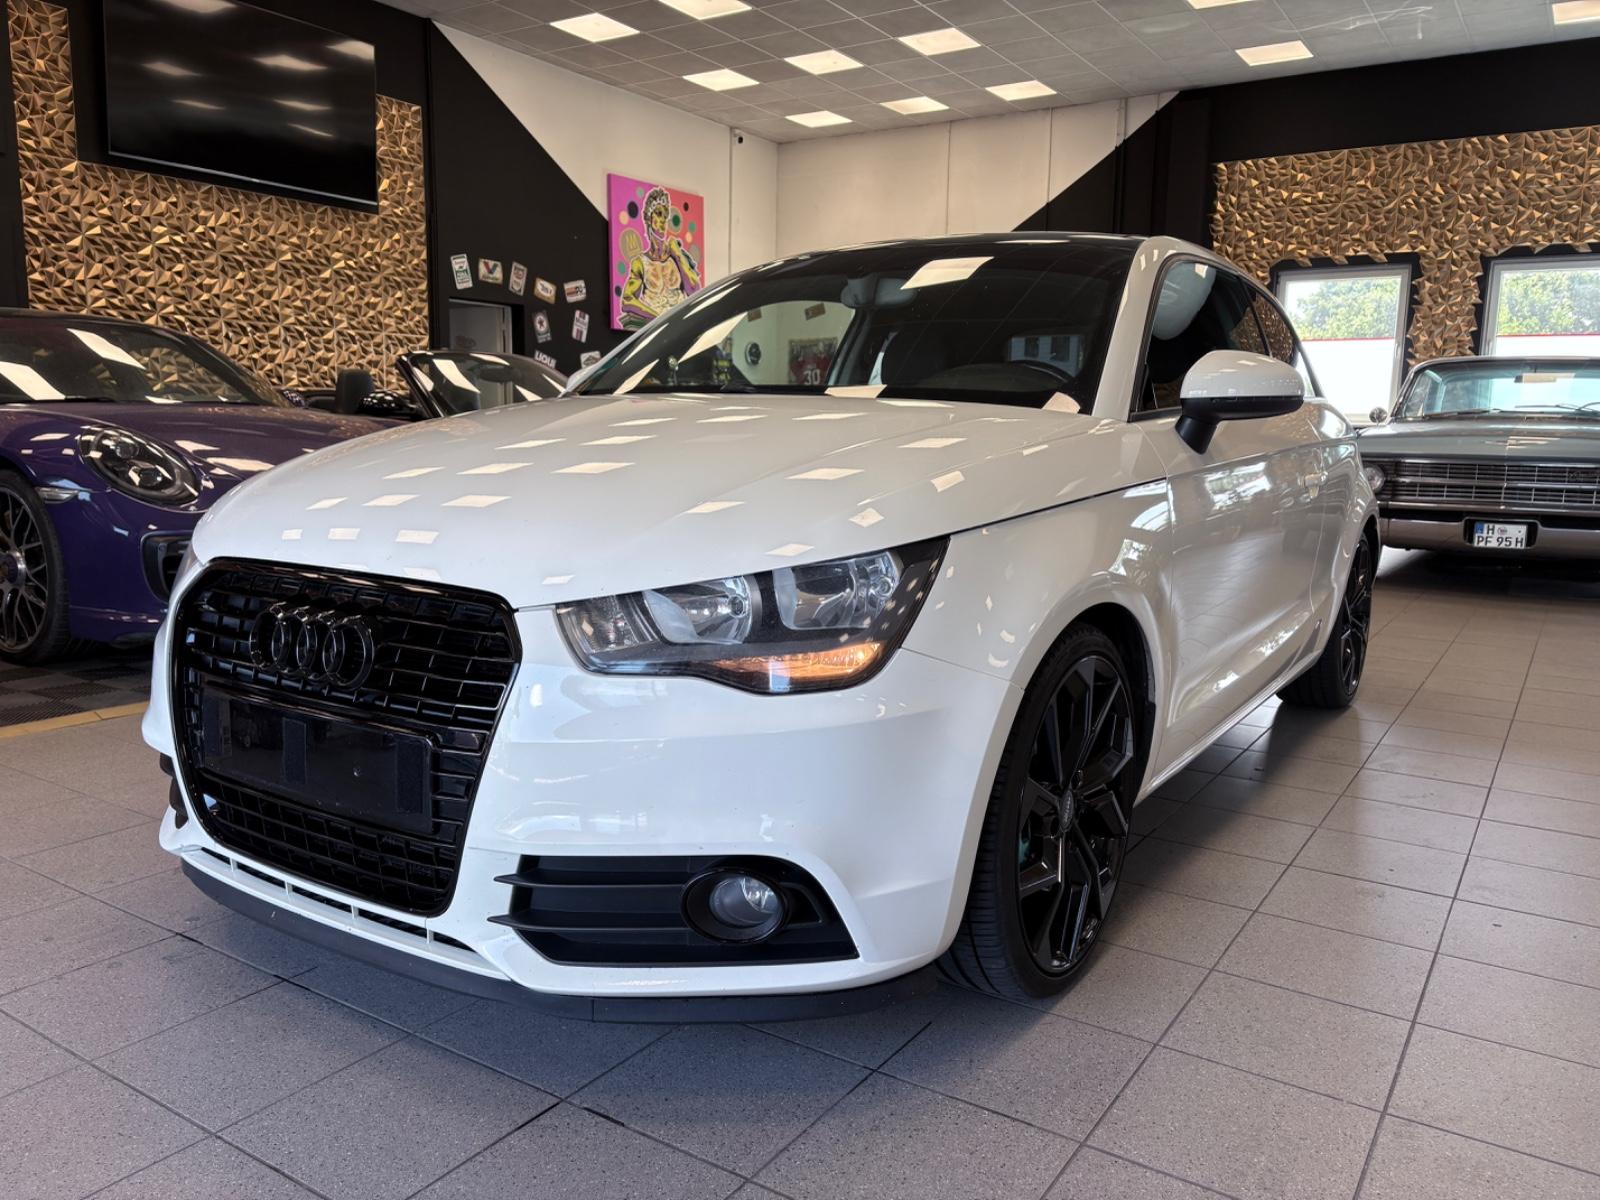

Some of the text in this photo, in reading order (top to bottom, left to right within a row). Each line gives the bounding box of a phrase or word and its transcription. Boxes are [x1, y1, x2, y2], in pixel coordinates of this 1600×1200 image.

[803, 369, 820, 385] 30
[1487, 524, 1495, 535] H
[1477, 536, 1524, 547] PF 95 H
